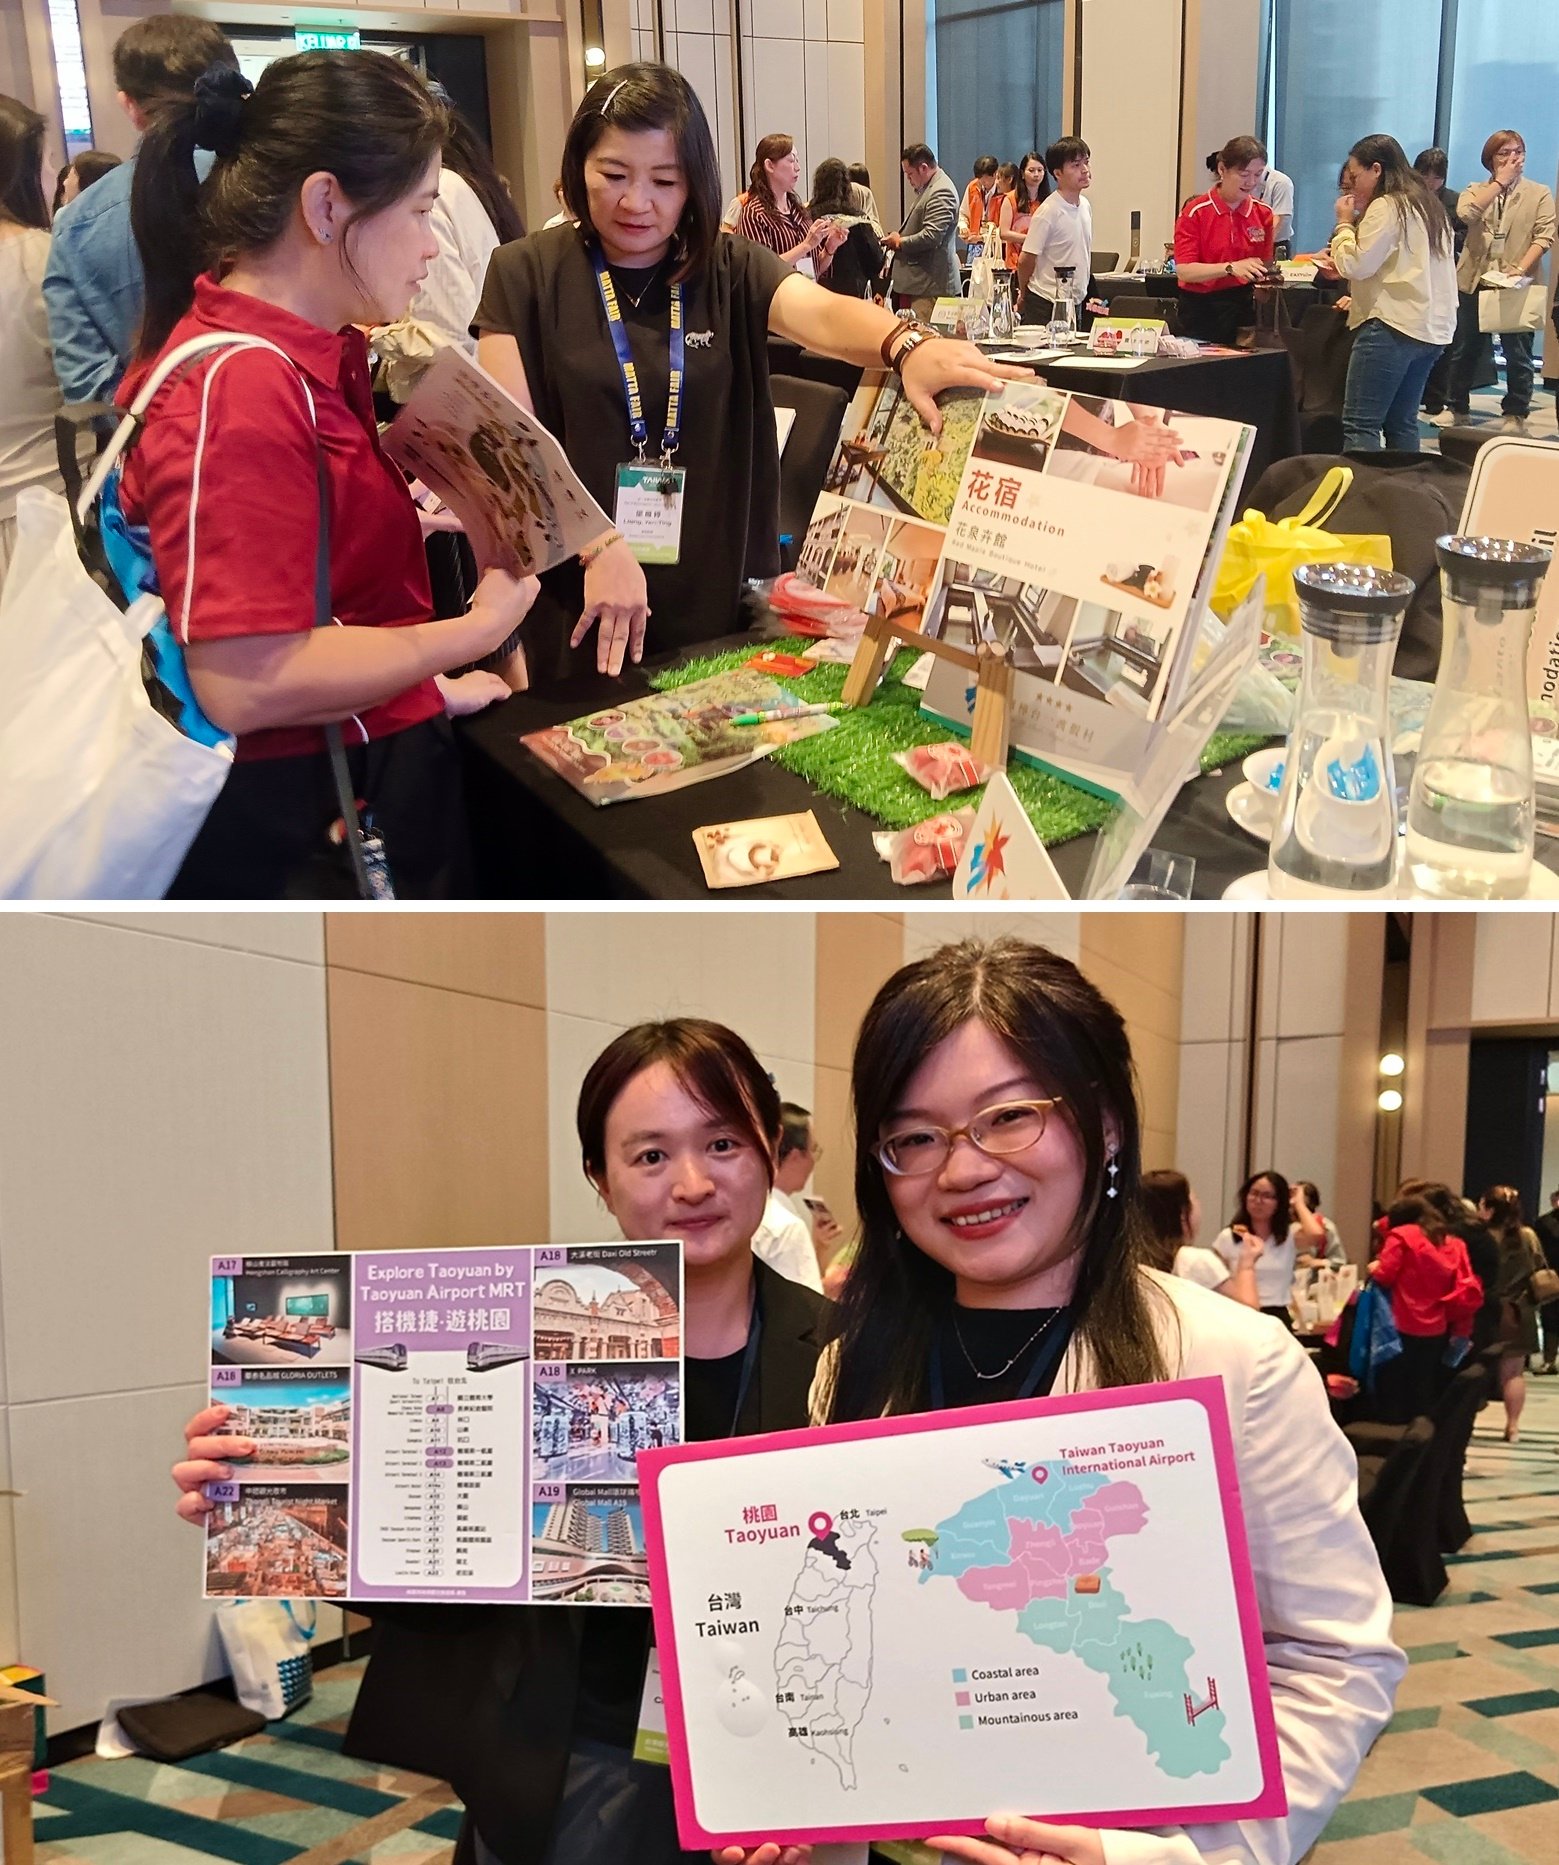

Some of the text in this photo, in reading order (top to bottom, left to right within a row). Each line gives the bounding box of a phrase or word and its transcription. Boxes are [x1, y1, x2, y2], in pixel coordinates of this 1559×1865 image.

[671, 283, 680, 299] FAI
[607, 300, 622, 322] FAIR
[623, 362, 643, 419] MATTA FAIR
[666, 370, 681, 427] MATTA FAIR
[967, 469, 1022, 510] 花宿
[961, 500, 1066, 537] Accommodation
[955, 521, 1008, 549] 花泉卉館
[540, 1251, 561, 1261] A18
[602, 1250, 617, 1258] Daxi
[618, 1249, 632, 1257] Old
[218, 1261, 237, 1271] A17
[367, 1263, 514, 1281] Explore Taoyuan by
[360, 1282, 526, 1303] Taoyuan Airport MRT
[281, 1371, 307, 1379] GLORIA
[307, 1371, 338, 1379] OUTLETS
[539, 1367, 561, 1377] A18
[1059, 1439, 1165, 1459] Taiwan Taoyuan
[1062, 1451, 1196, 1476] International Airport
[214, 1486, 234, 1496] A22
[538, 1486, 560, 1496] A19
[572, 1488, 596, 1496] Global
[742, 1504, 778, 1525] 桃園
[839, 1508, 887, 1520] 台北 Taipei
[725, 1524, 801, 1544] Taoyuan
[707, 1592, 742, 1612] 台灣
[784, 1604, 839, 1616] 台中 Taichung
[695, 1620, 760, 1638] Taiwan
[971, 1666, 1040, 1681] Coastal area
[775, 1692, 824, 1704] 台南 Tainan
[974, 1690, 1036, 1703] Urban area
[978, 1710, 1079, 1727] Mountainous area
[788, 1726, 850, 1738] 高雄 Kaohsiung
